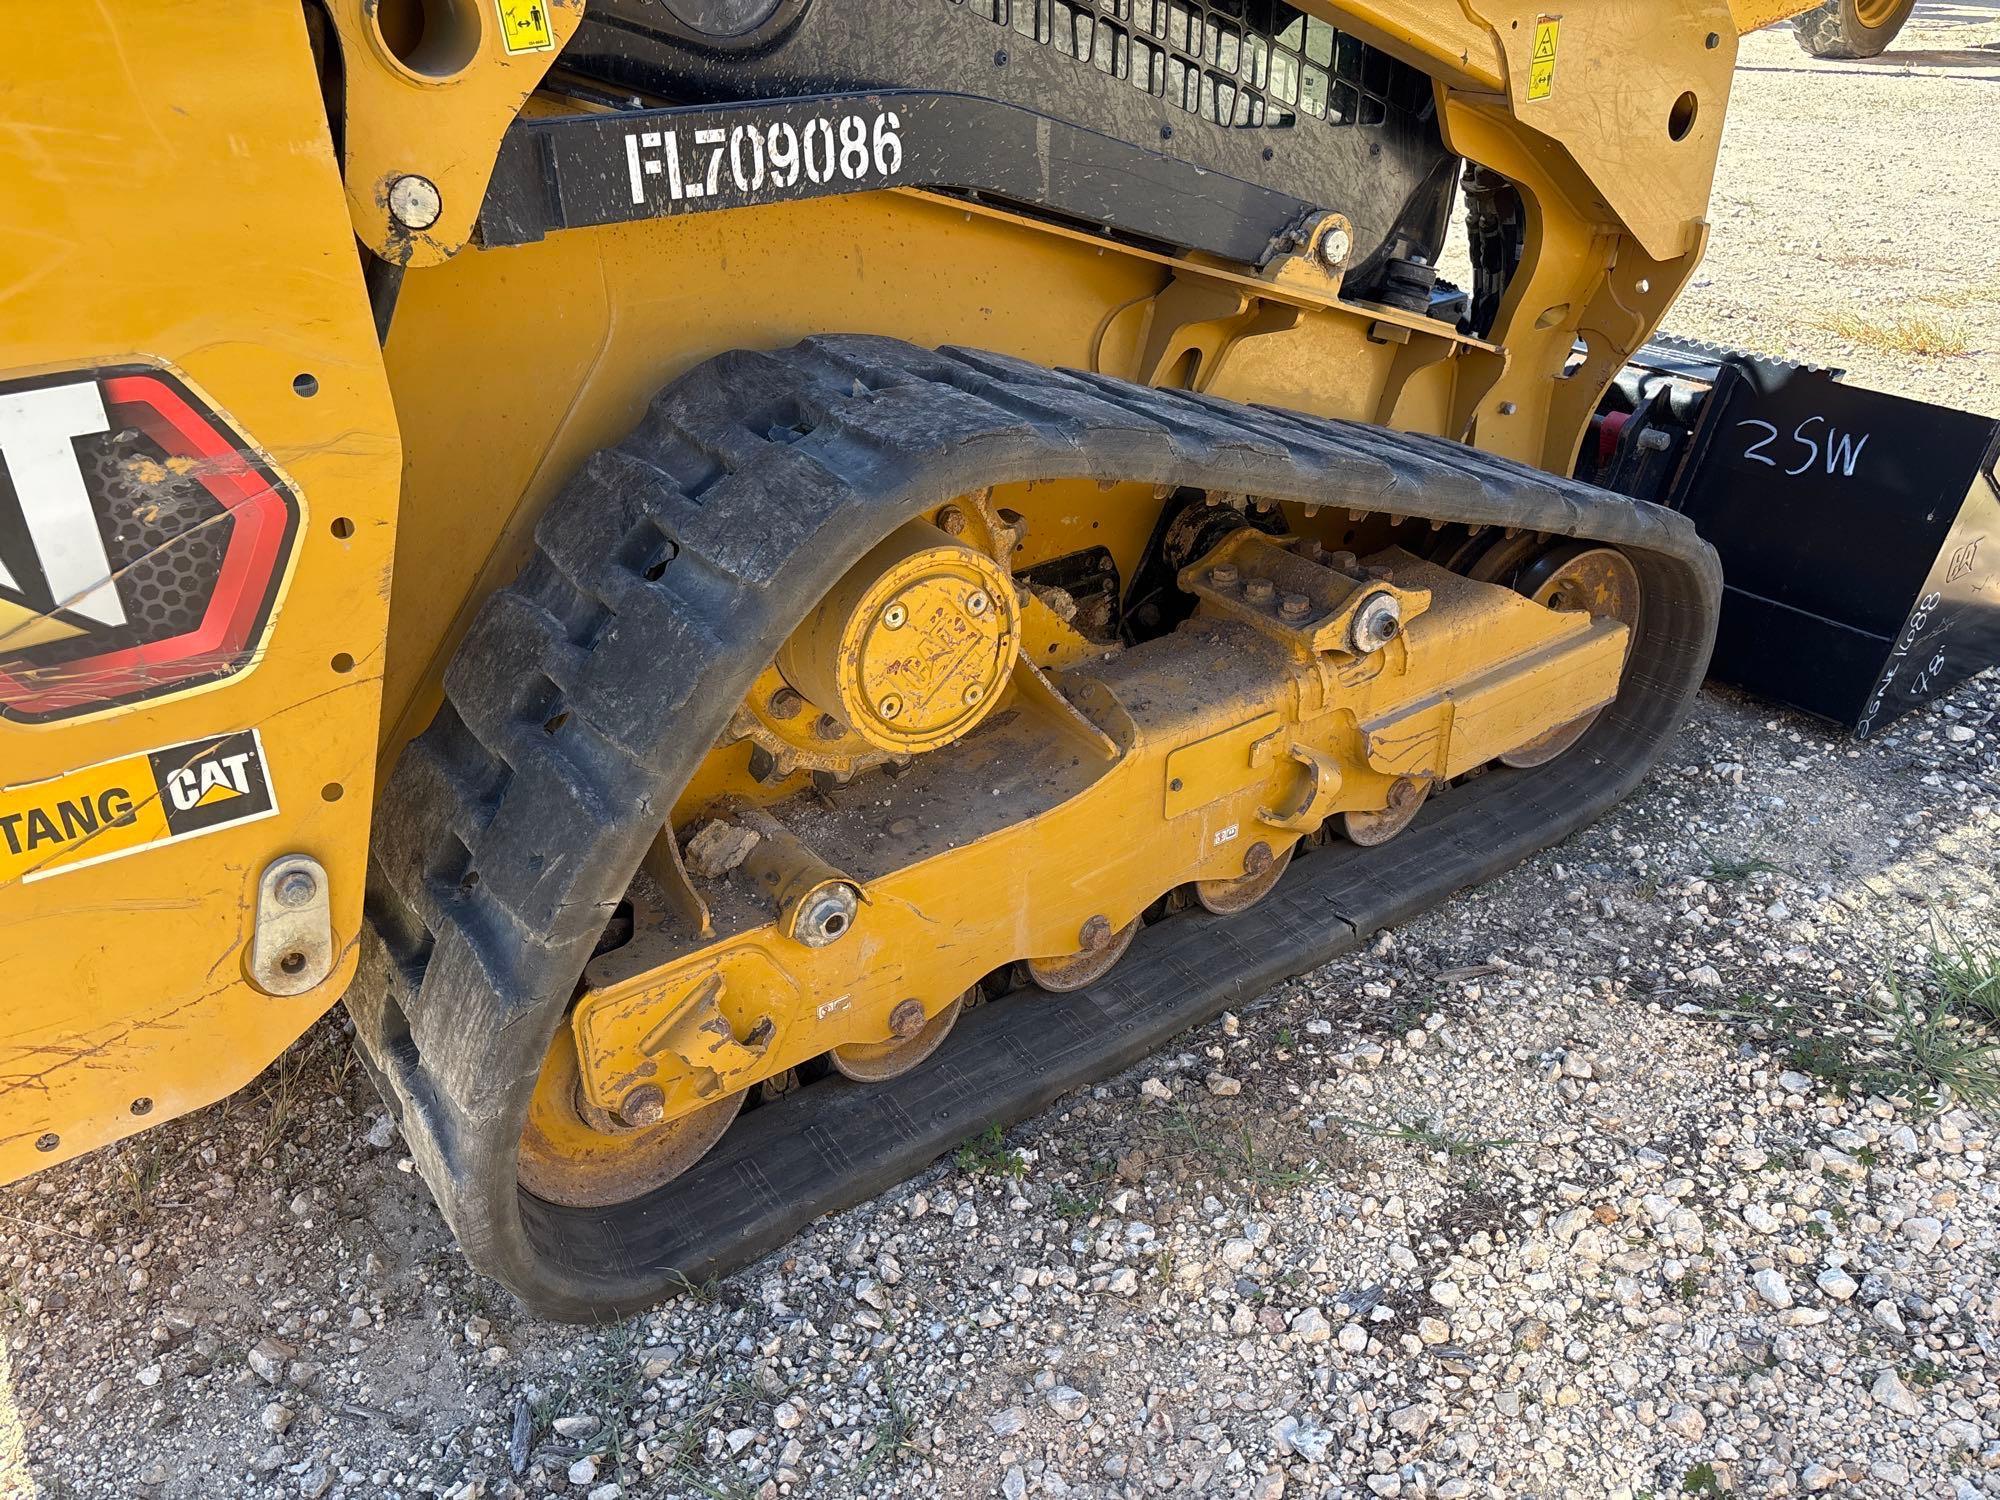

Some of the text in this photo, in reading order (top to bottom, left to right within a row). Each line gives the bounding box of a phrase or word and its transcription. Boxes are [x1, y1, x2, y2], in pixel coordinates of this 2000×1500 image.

[624, 111, 903, 205] FL709086
[0, 752, 251, 856] TANG CAT
